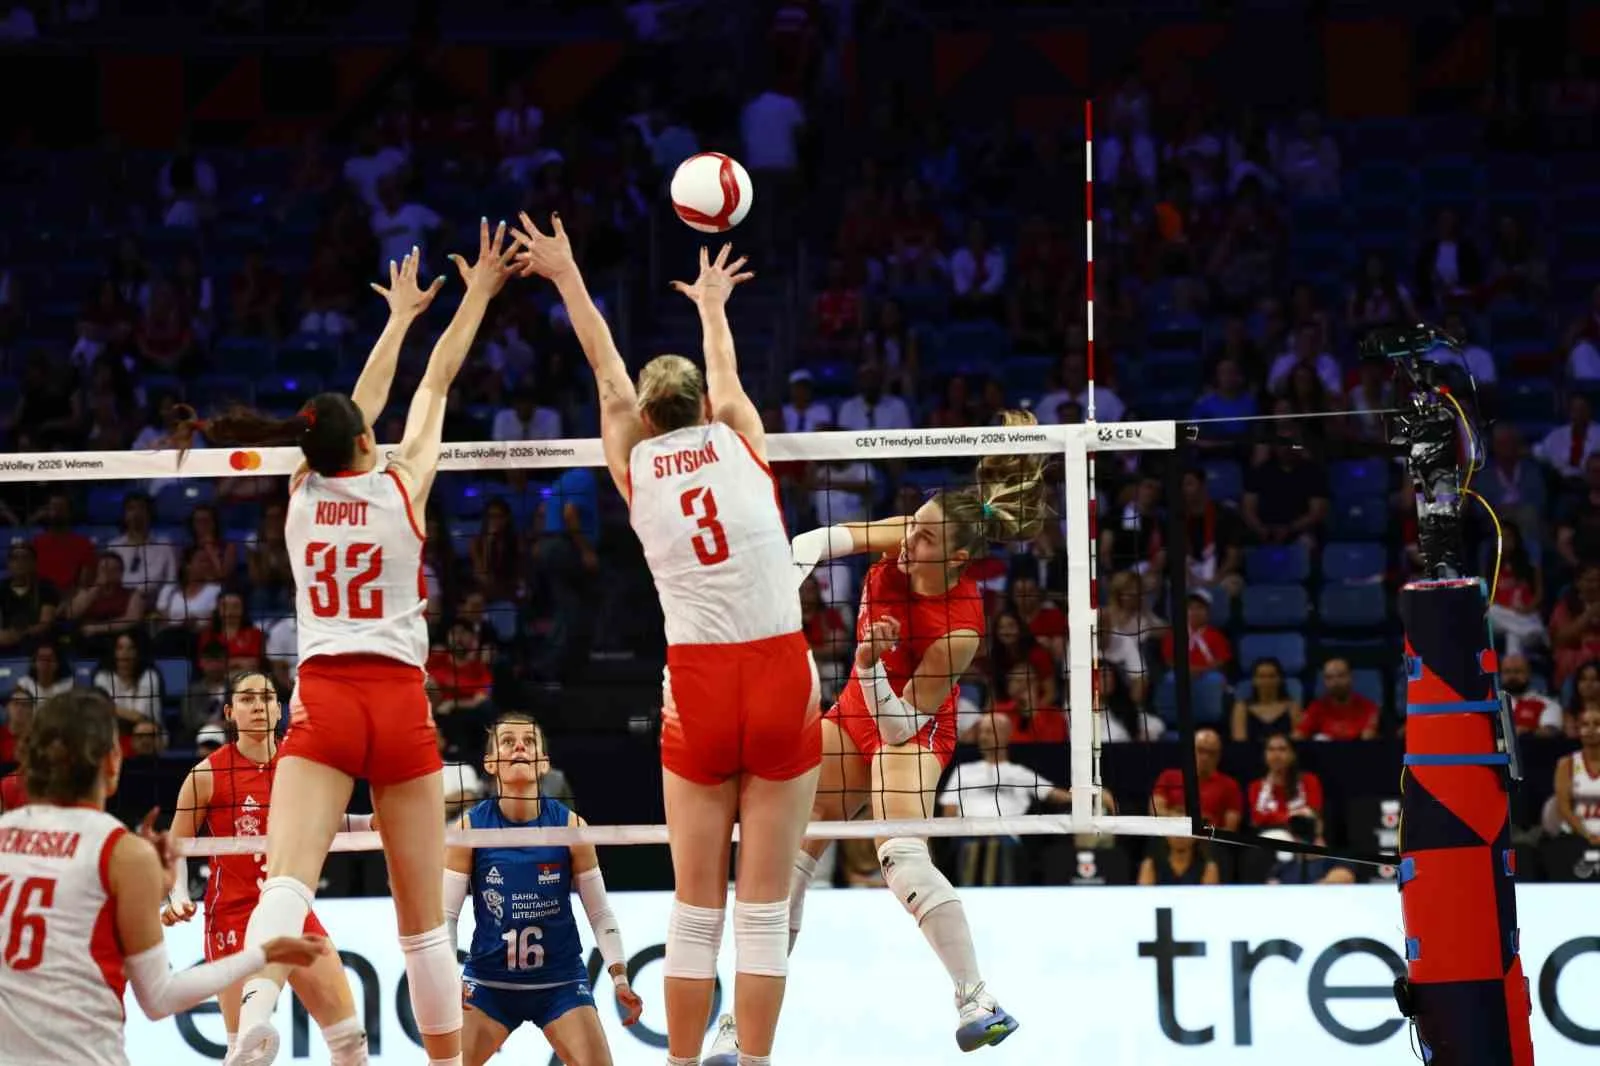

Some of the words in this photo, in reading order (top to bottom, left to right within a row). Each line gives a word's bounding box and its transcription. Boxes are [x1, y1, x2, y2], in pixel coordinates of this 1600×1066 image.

[855, 438, 878, 448] CEV
[879, 436, 923, 447] Trendyol
[925, 434, 978, 445] EuroVolley
[980, 432, 1006, 444] 2026
[1007, 432, 1047, 442] Women
[1115, 429, 1142, 438] CEV
[455, 448, 507, 460] EuroVolley
[509, 447, 534, 458] 2026
[535, 446, 575, 457] Women
[653, 440, 720, 479] STYSIAK
[38, 460, 62, 470] 2026
[64, 459, 104, 469] Women
[315, 500, 369, 527] KOPUT
[679, 486, 730, 567] 3
[304, 541, 384, 620] 32
[511, 893, 539, 901] БАНКА
[215, 929, 237, 951] 34
[501, 926, 545, 973] 16
